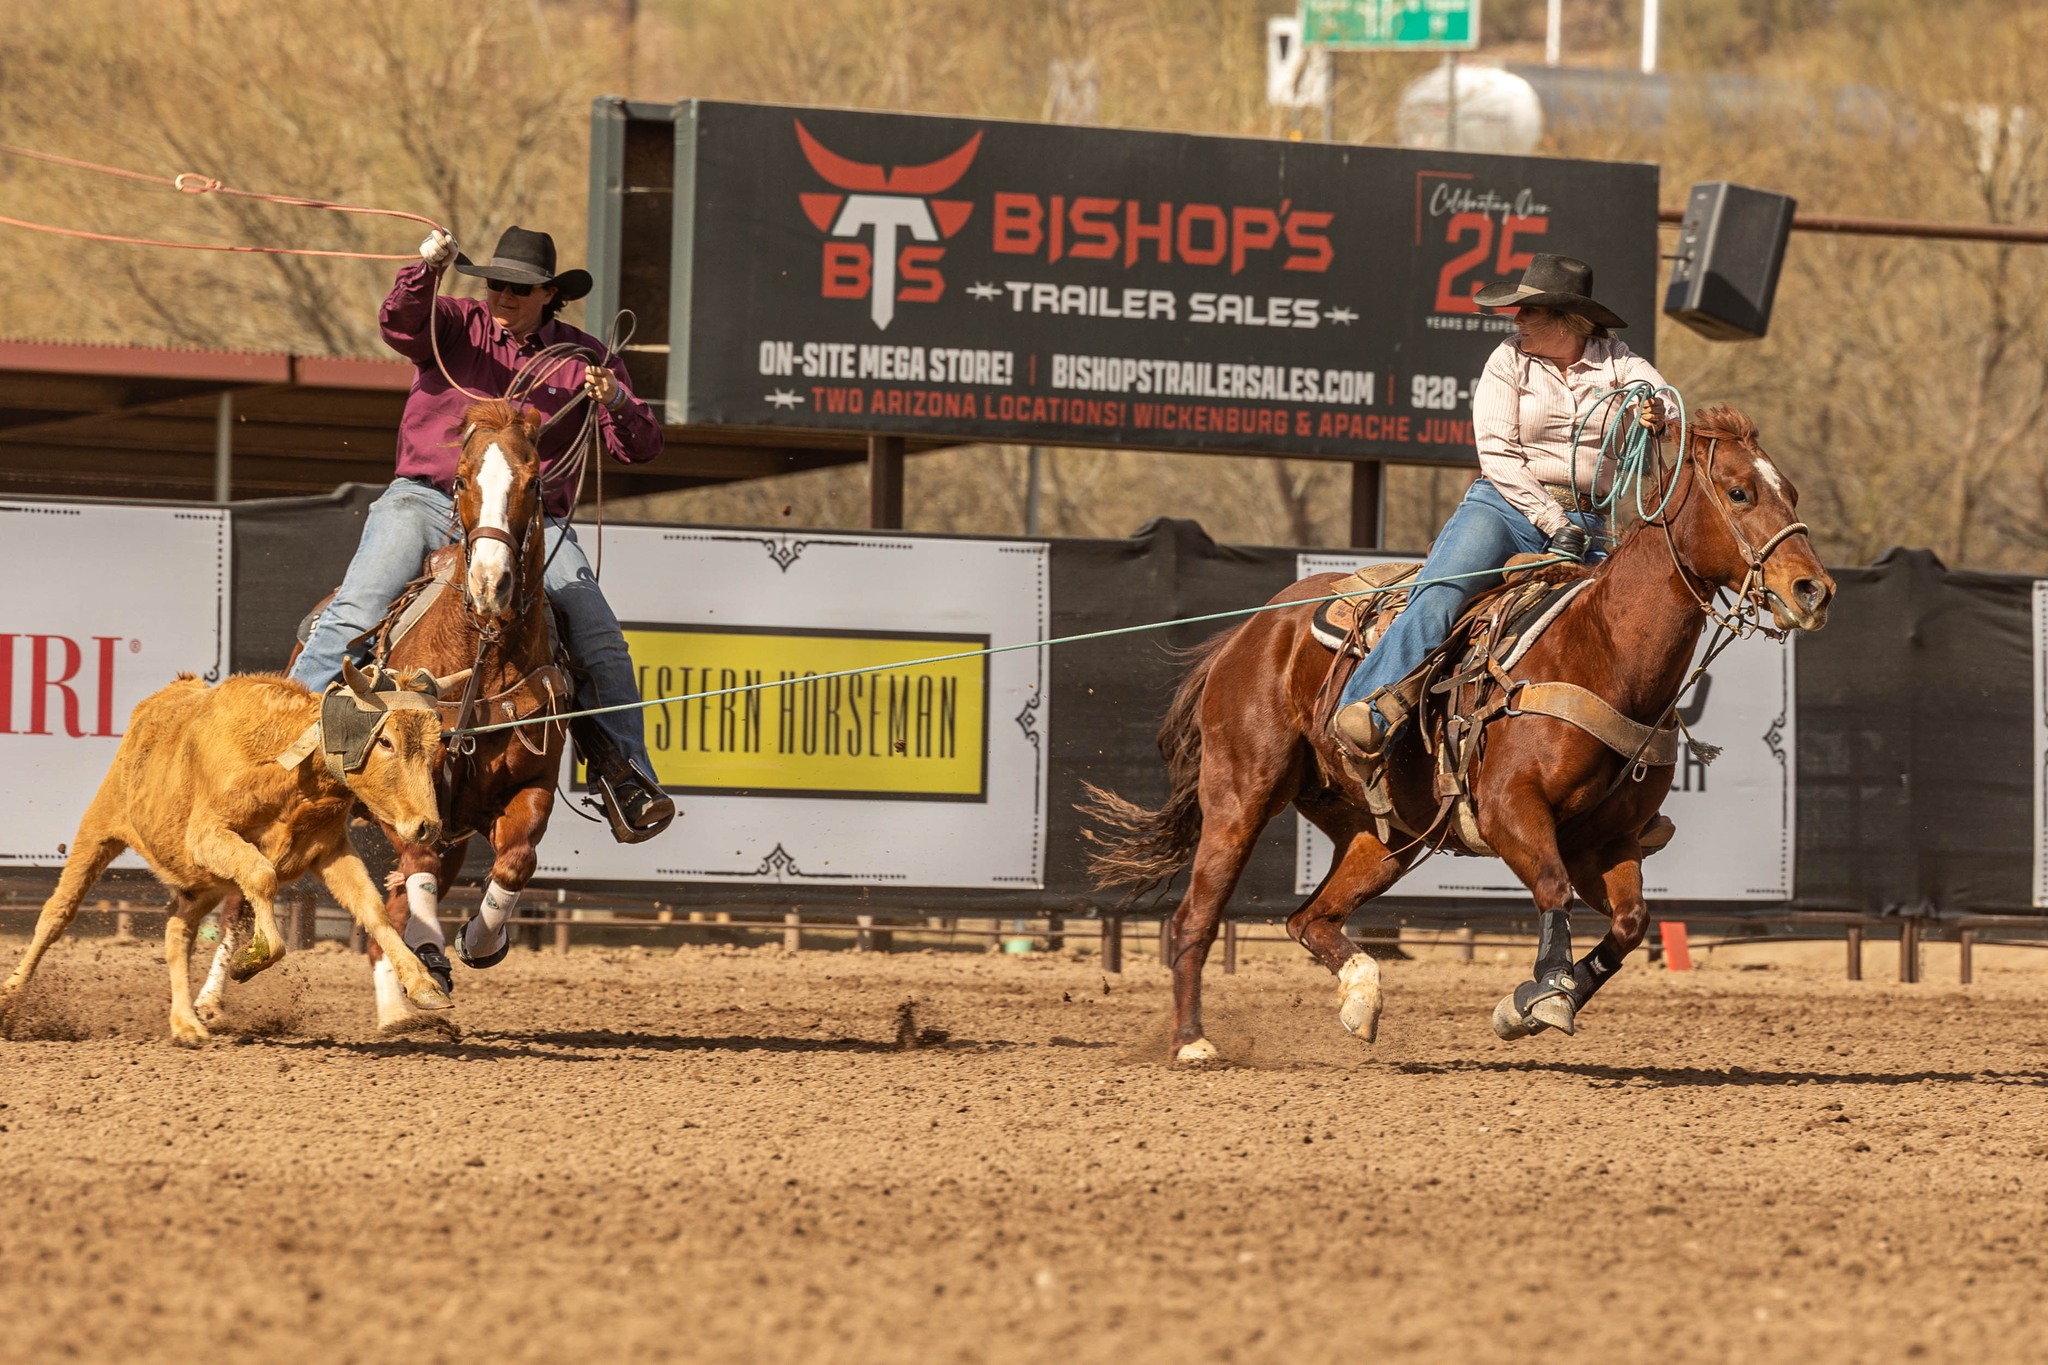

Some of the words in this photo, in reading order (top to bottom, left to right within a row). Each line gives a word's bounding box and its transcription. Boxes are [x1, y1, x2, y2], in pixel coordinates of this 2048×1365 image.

[993, 191, 1335, 277] BISHOP'S
[1004, 280, 1176, 321] TRAILER
[1188, 292, 1320, 329] SALES
[1426, 316, 1462, 331] YEARS
[1464, 318, 1481, 331] OF
[759, 340, 856, 379] ON-SITE
[859, 344, 926, 382] MEGA
[929, 347, 1014, 386] STORE!
[1052, 353, 1375, 406] BISHOPSTRAILERSALES.COM
[812, 386, 864, 415] TWO
[870, 389, 977, 419] ARIZONA
[984, 394, 1127, 428] LOCATIONS!
[1133, 402, 1288, 436] WICKENBURG
[1295, 410, 1312, 437] &
[1317, 411, 1410, 442] APACHE
[778, 670, 957, 759] HORSEMAN
